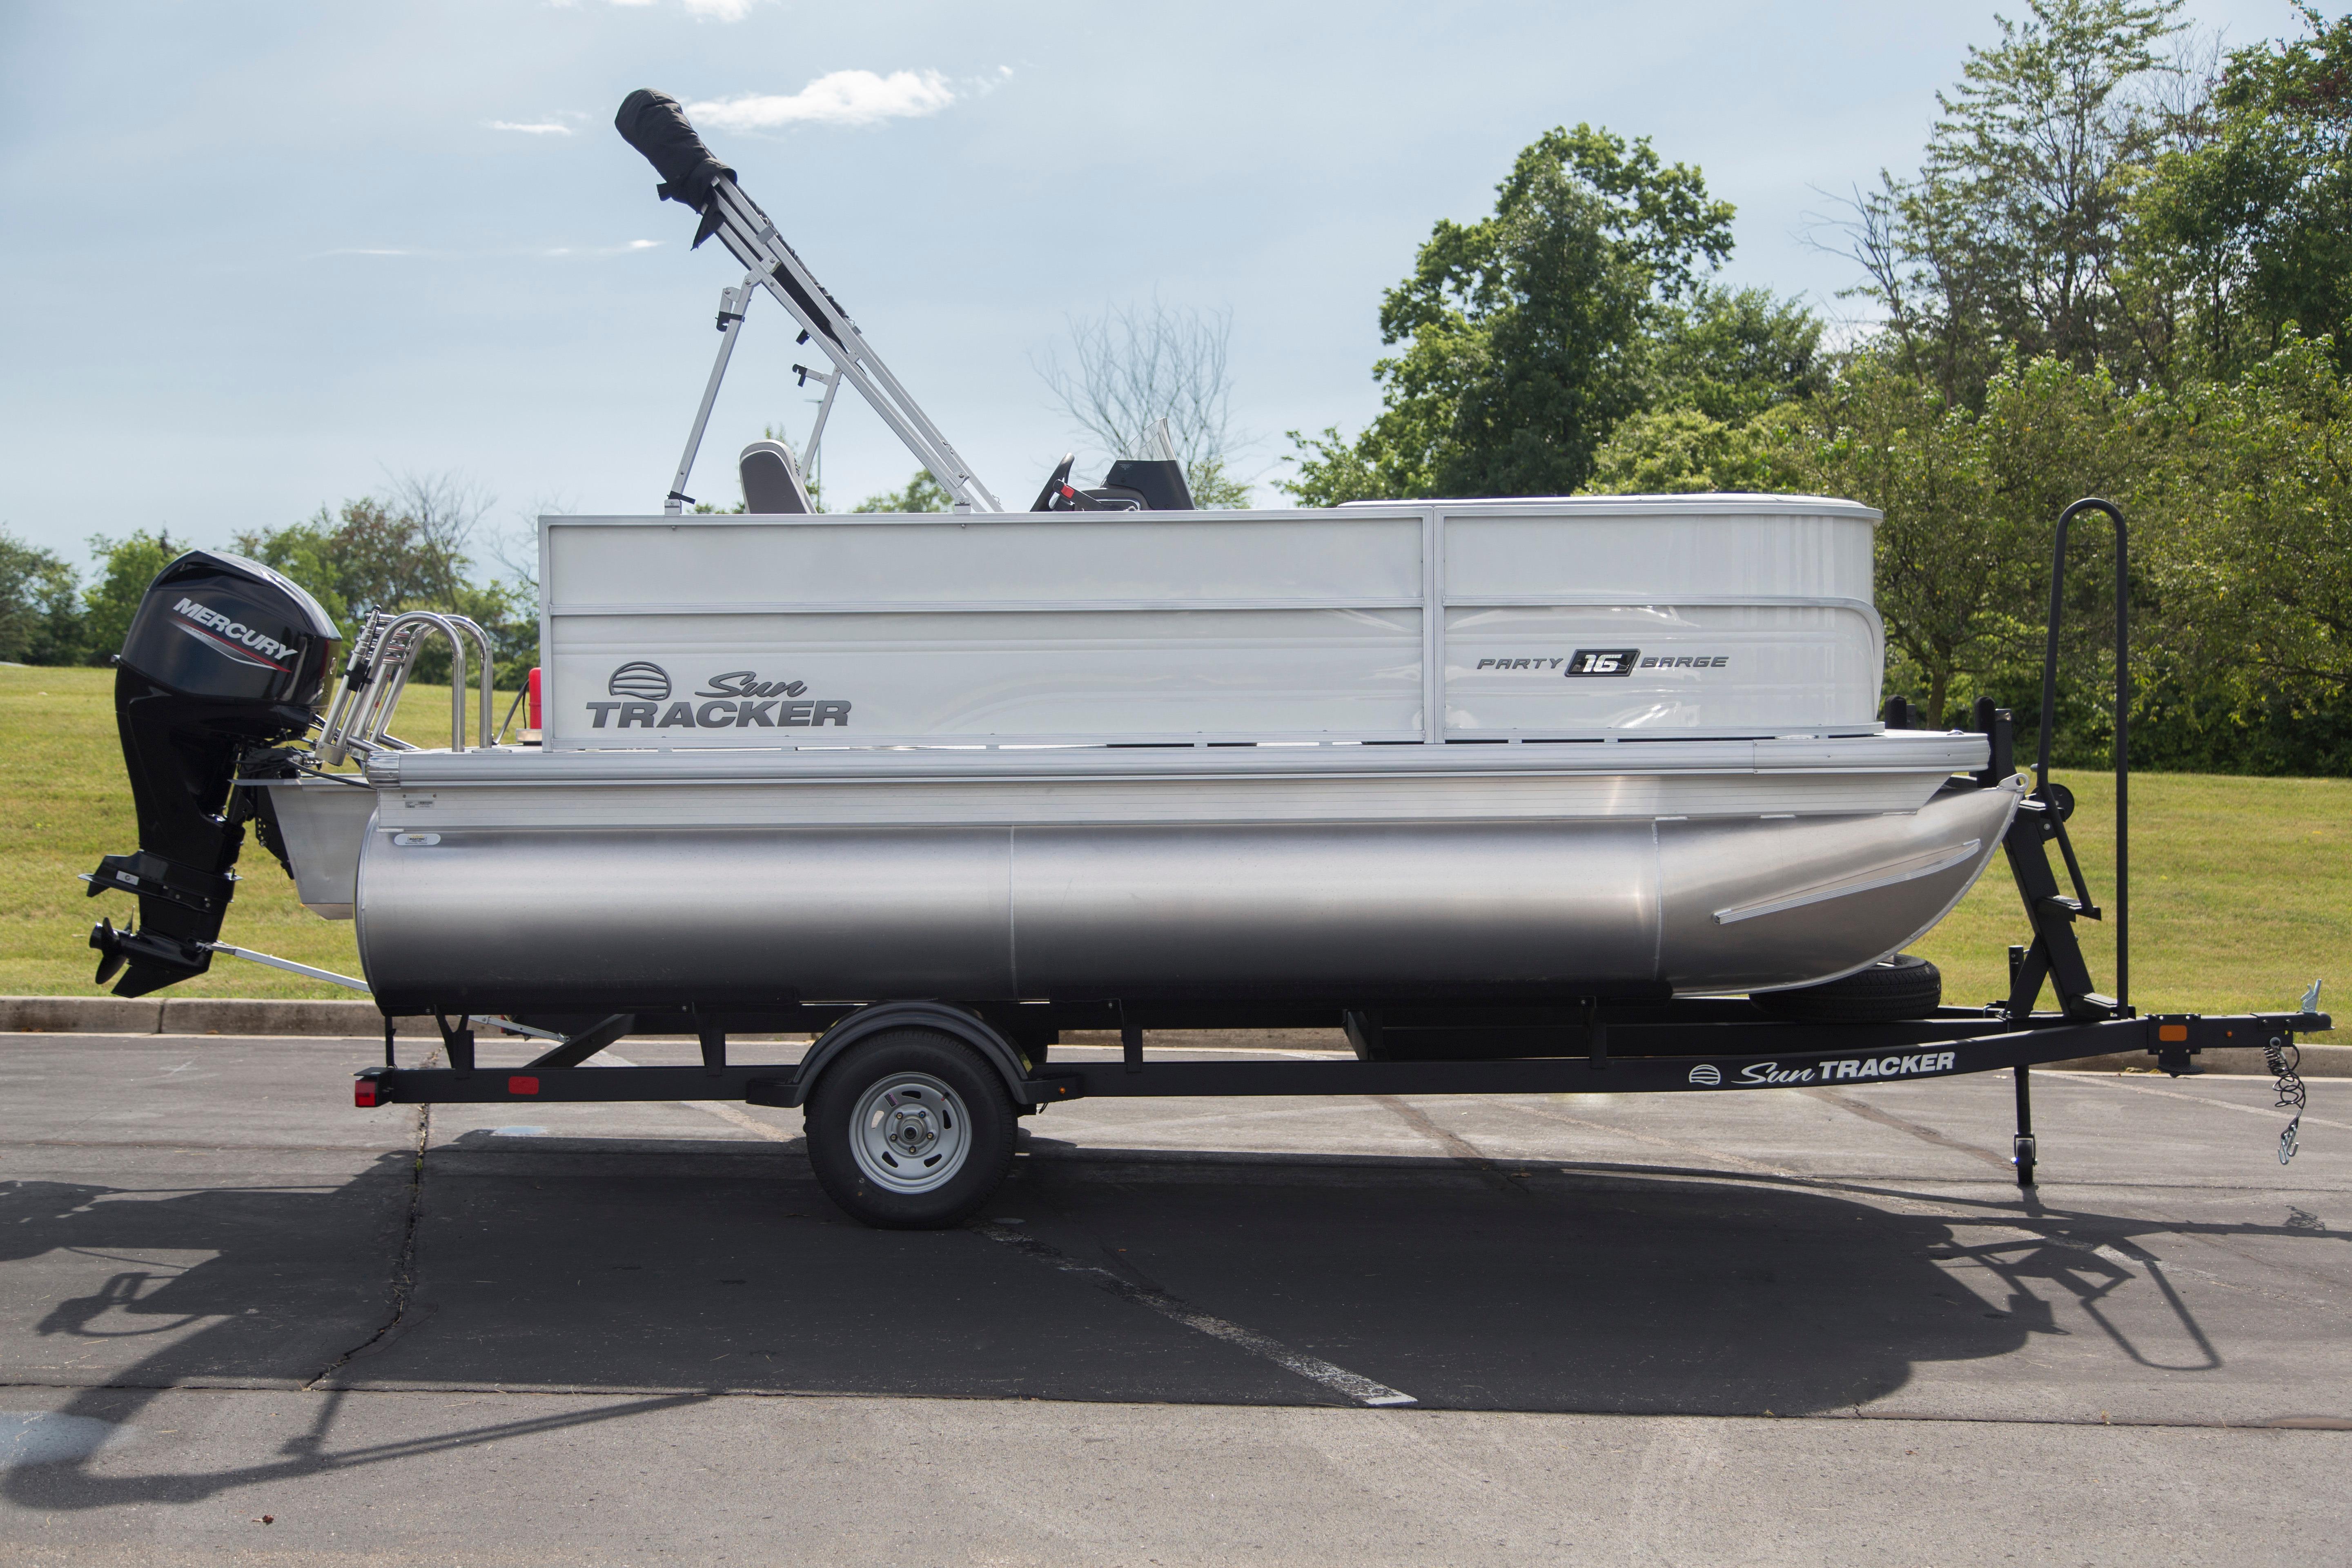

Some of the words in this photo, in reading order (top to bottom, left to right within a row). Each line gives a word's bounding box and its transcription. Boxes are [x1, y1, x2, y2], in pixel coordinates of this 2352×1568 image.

[173, 598, 298, 660] MERCURY
[1477, 658, 1564, 670] PARTY
[1582, 654, 1623, 673] 16
[1640, 657, 1729, 668] BARGE
[694, 671, 808, 698] Sun
[586, 700, 852, 728] TRACKER
[1731, 1062, 1815, 1084] Sun
[1819, 1051, 1955, 1079] TRACKER
